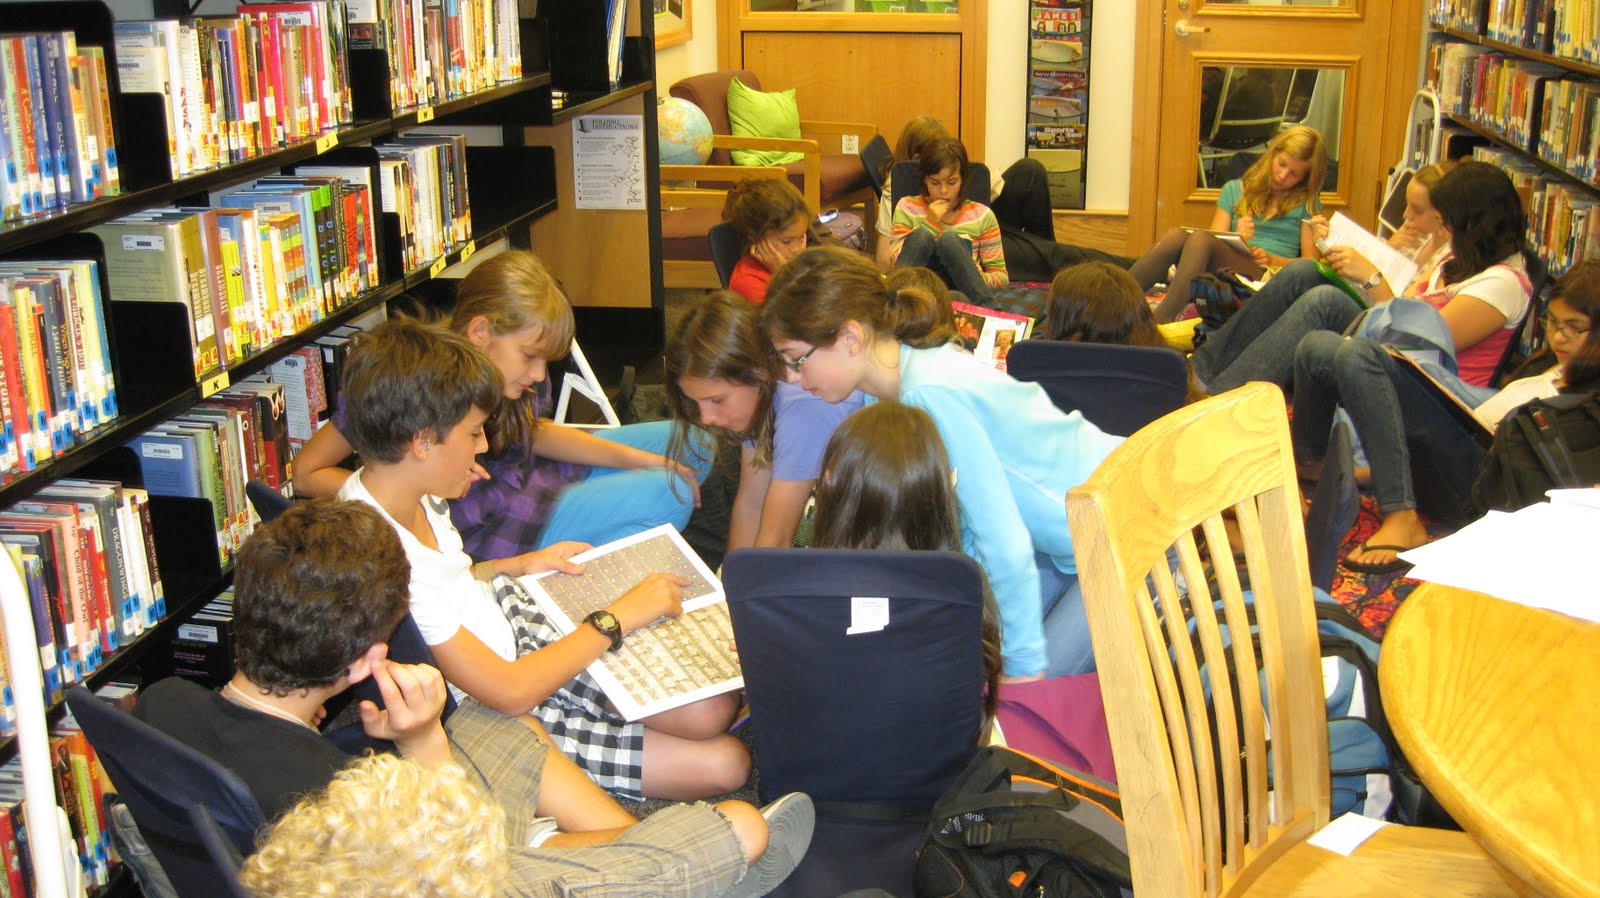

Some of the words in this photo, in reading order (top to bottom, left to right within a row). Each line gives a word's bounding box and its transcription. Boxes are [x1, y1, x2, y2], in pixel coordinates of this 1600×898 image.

[213, 380, 220, 391] K
[73, 549, 83, 575] Child
[112, 527, 129, 600] DRAGONWINGS
[77, 577, 84, 585] of
[81, 604, 90, 623] Owl
